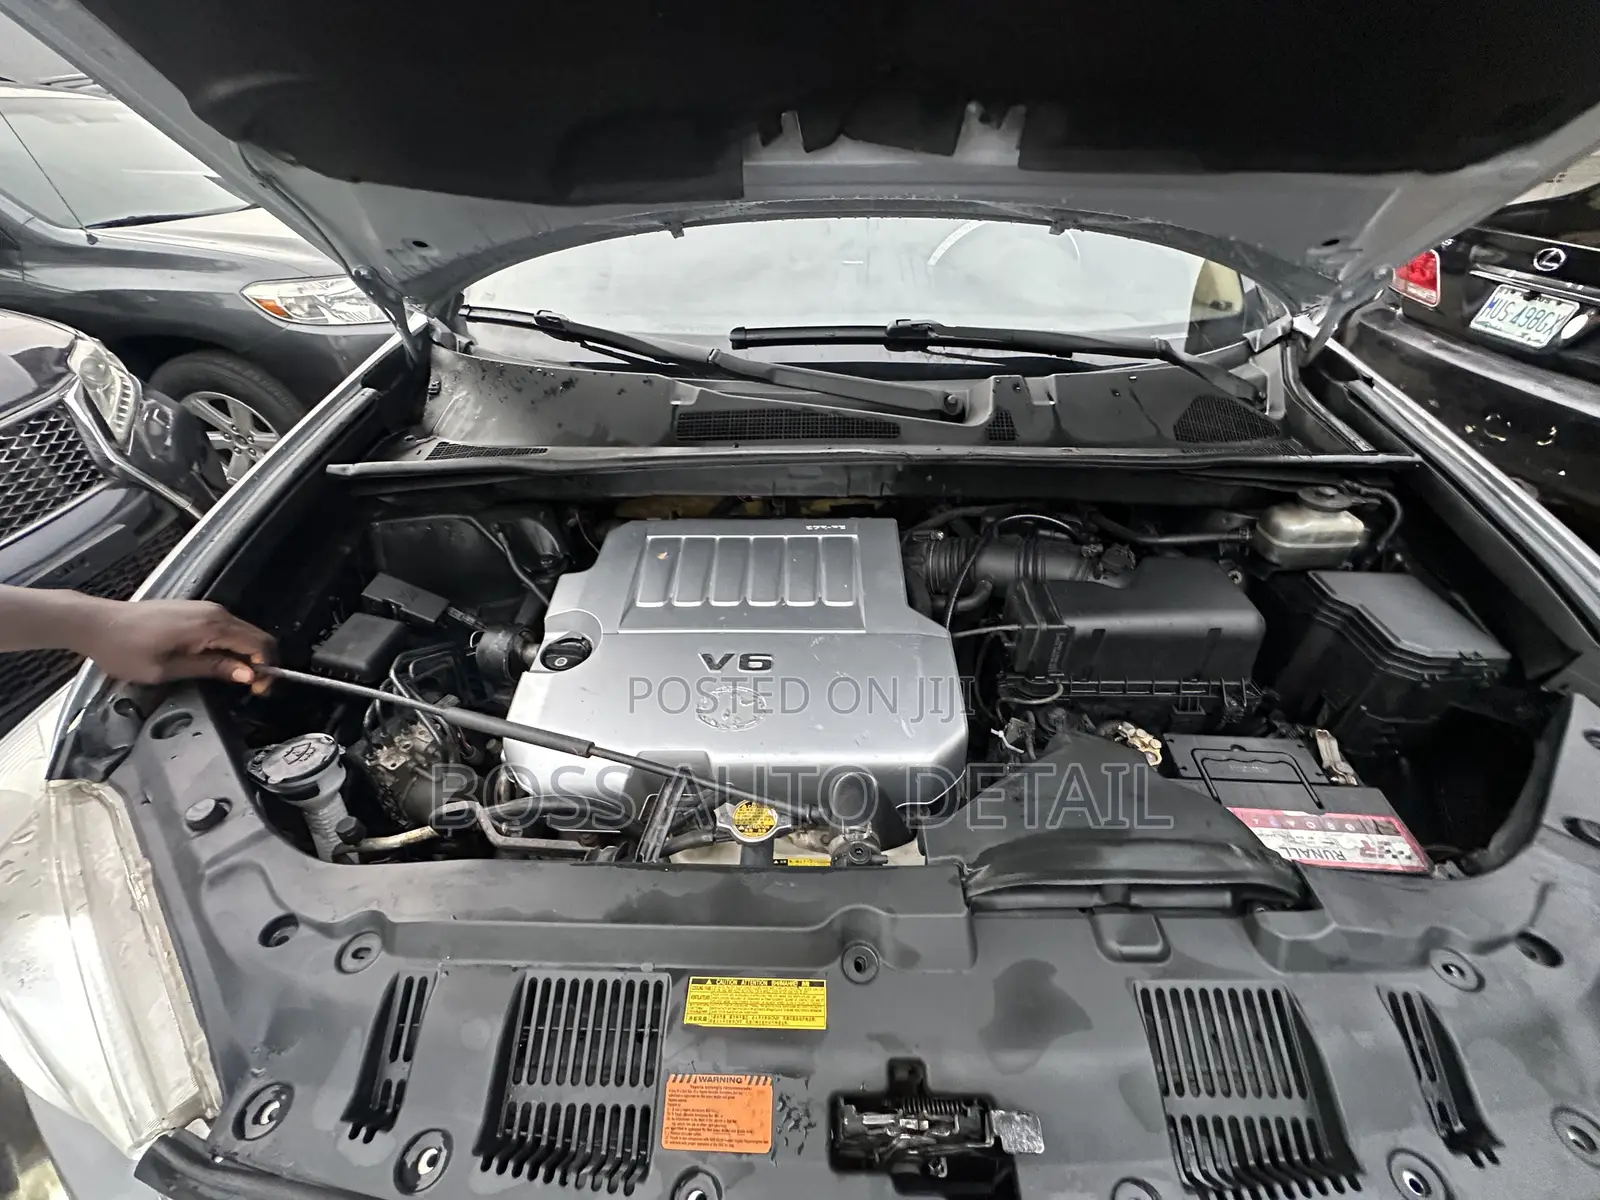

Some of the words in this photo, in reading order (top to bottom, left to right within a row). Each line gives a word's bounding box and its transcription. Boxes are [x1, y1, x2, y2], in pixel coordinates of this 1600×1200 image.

[698, 652, 775, 673] V6
[1279, 846, 1348, 862] RUNALL
[698, 1076, 743, 1084] WARNING
